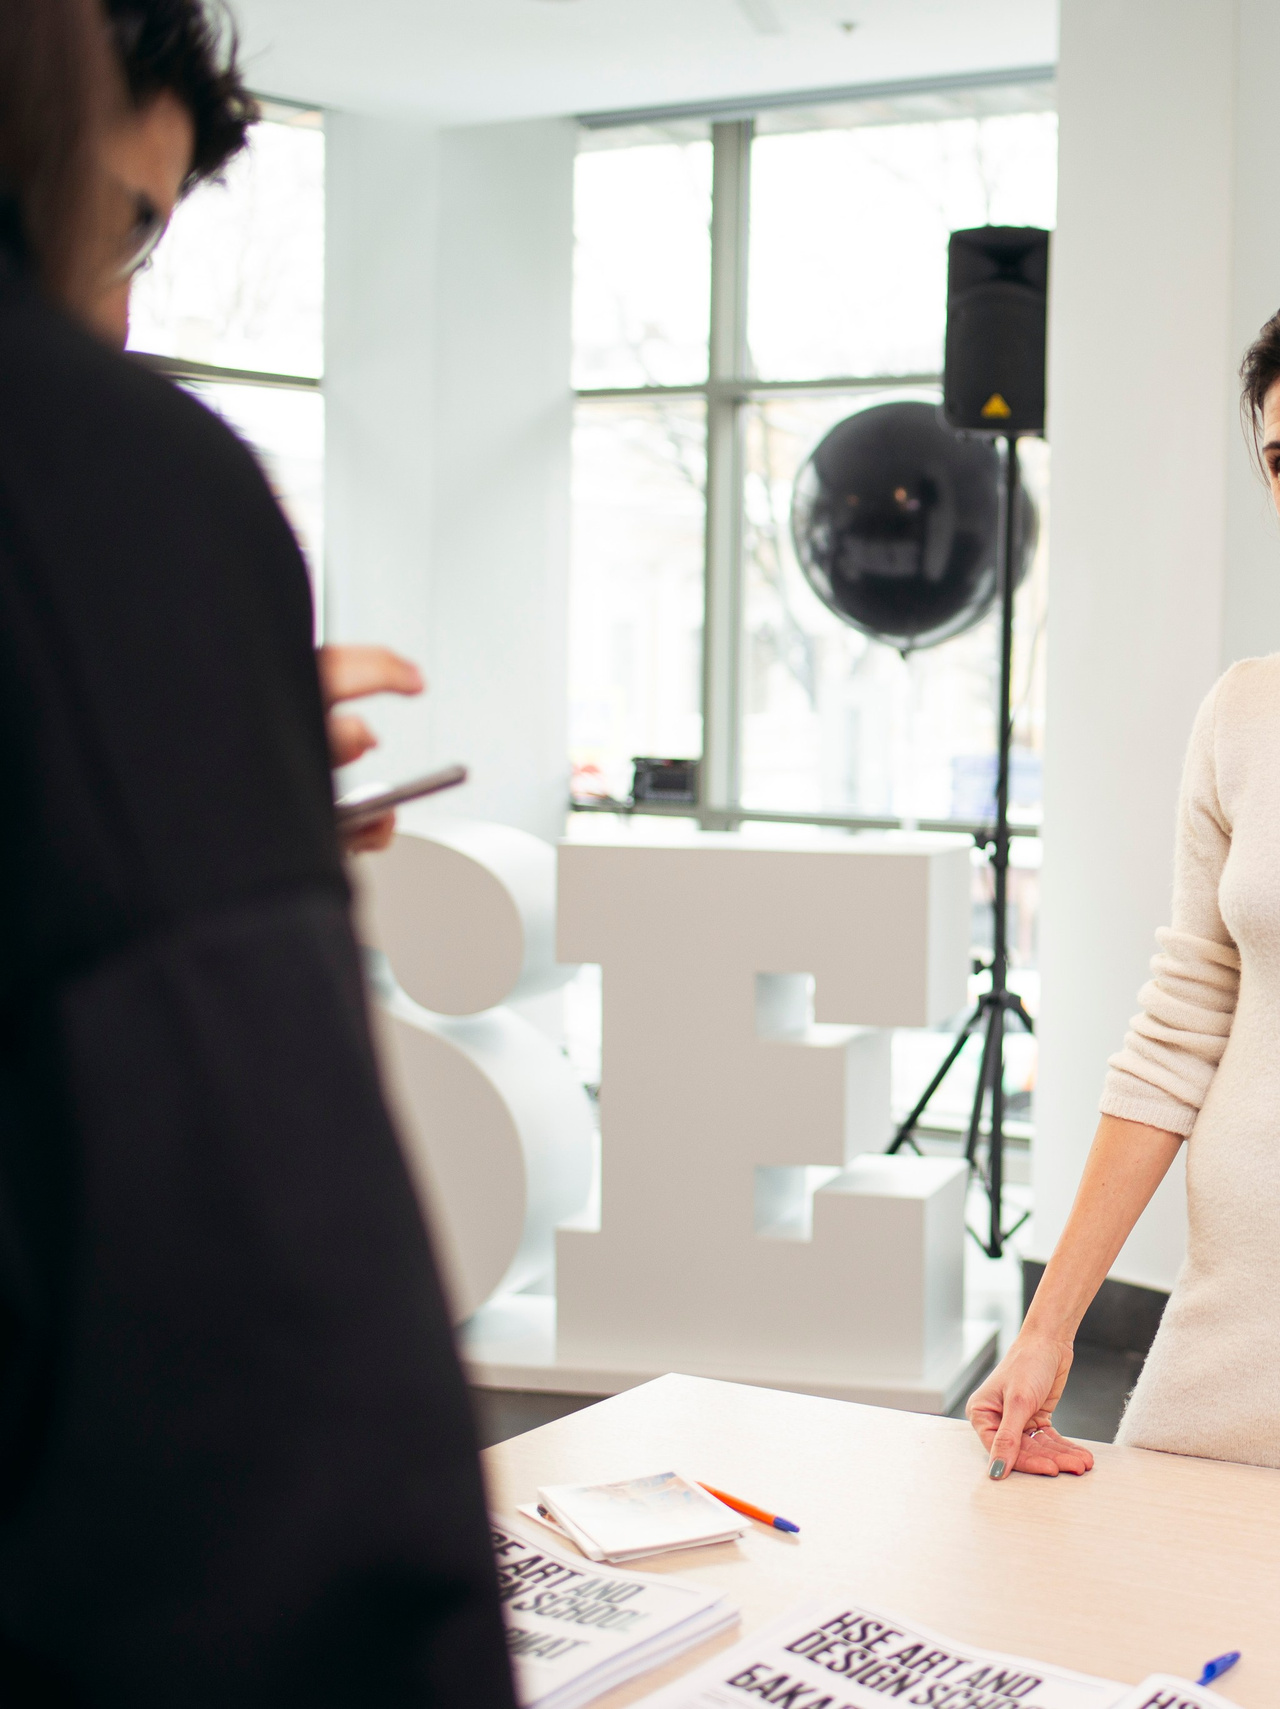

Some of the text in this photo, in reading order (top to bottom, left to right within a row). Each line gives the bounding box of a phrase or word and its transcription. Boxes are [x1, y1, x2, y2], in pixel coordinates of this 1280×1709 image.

[499, 1554, 585, 1589] ART
[562, 1577, 647, 1604] AND
[785, 1630, 926, 1698] DESIGN
[819, 1611, 1044, 1699] HSE ART AND
